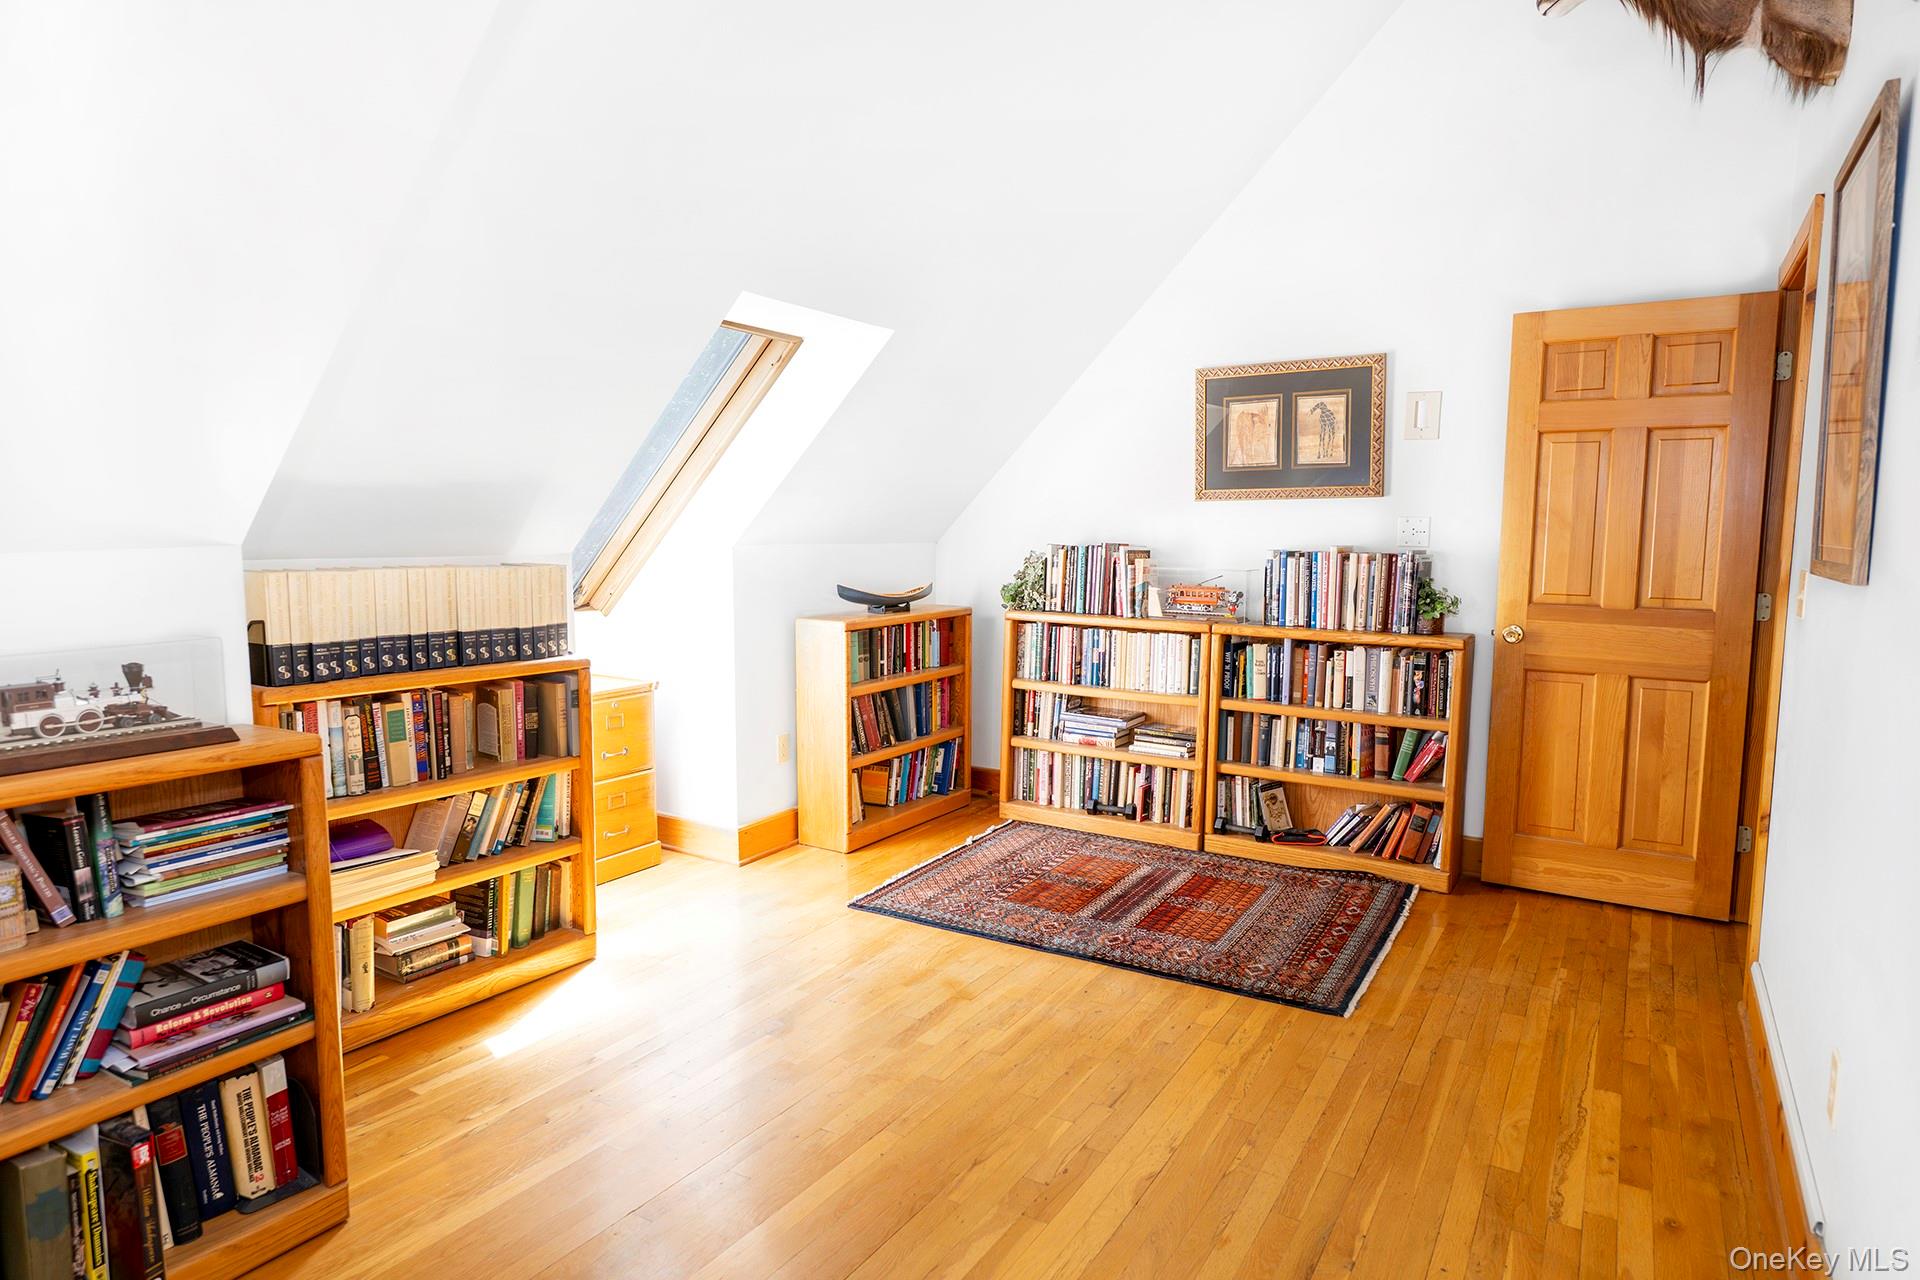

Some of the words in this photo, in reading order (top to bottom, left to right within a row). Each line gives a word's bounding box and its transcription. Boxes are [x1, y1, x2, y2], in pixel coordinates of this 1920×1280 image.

[1223, 671, 1231, 689] PROOF
[151, 1002, 182, 1017] Chance
[190, 984, 242, 1005] Circumstance
[73, 1010, 89, 1033] LAND
[155, 1015, 192, 1033] Reform
[192, 1010, 201, 1022] &
[242, 1086, 252, 1101] THE
[197, 1103, 208, 1121] THE
[244, 1102, 257, 1136] PEOPLE'S
[200, 1121, 215, 1158] PEOPLE'S
[250, 1135, 263, 1173] ALMANAC
[254, 1173, 264, 1183] 2
[88, 1171, 100, 1223] Shakespeare
[93, 1226, 104, 1267] Dummies
